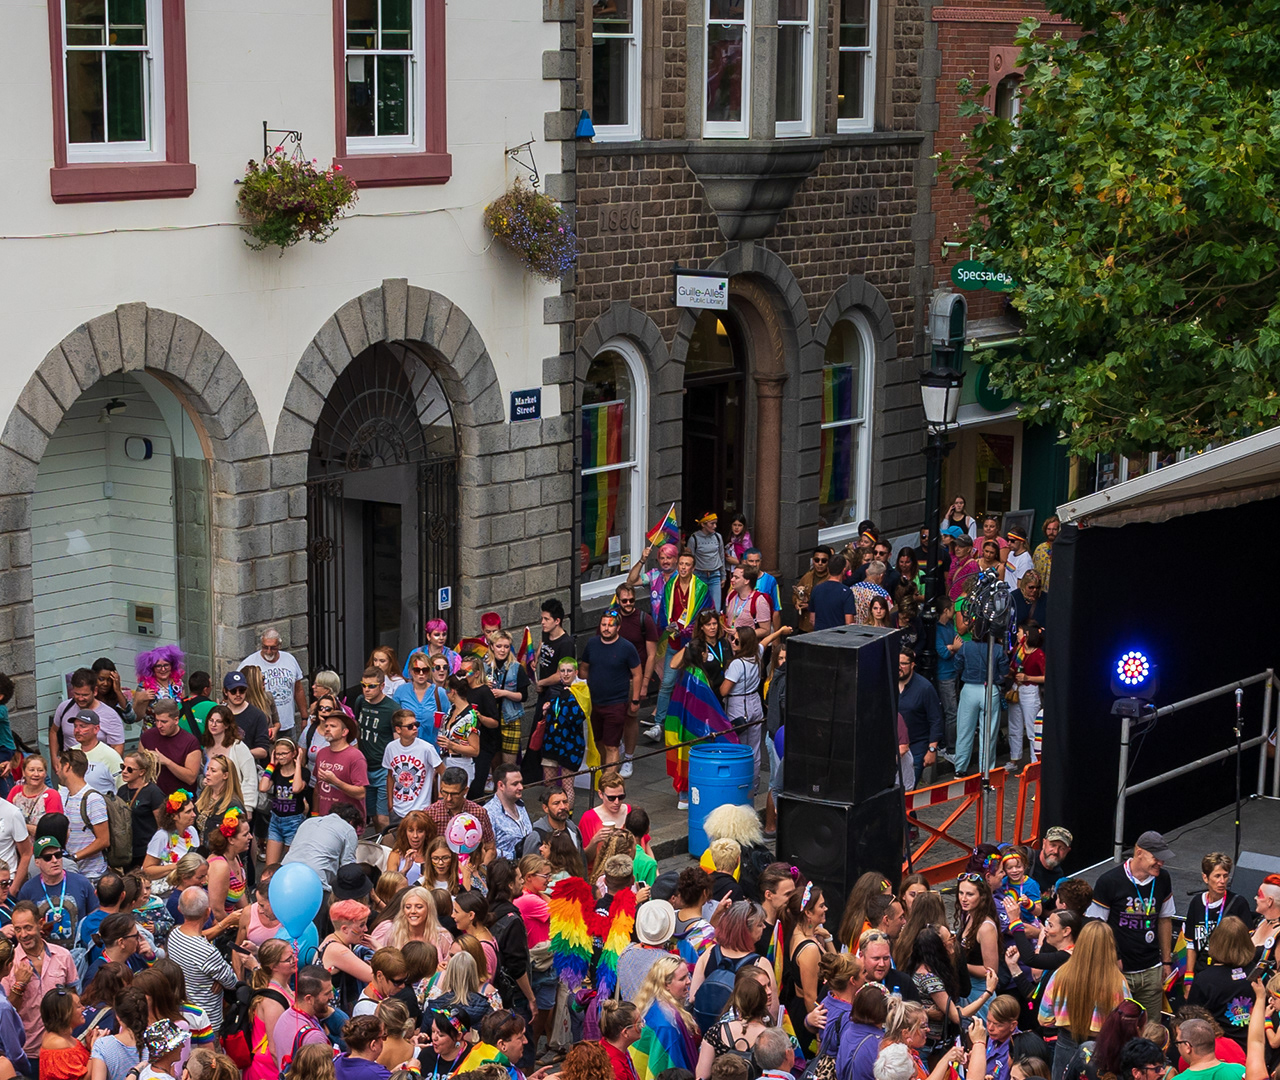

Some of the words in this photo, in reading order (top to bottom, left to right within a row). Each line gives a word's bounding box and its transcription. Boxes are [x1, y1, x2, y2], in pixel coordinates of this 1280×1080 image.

[601, 209, 640, 231] 1856
[515, 395, 537, 405] Market
[516, 406, 535, 415] Street
